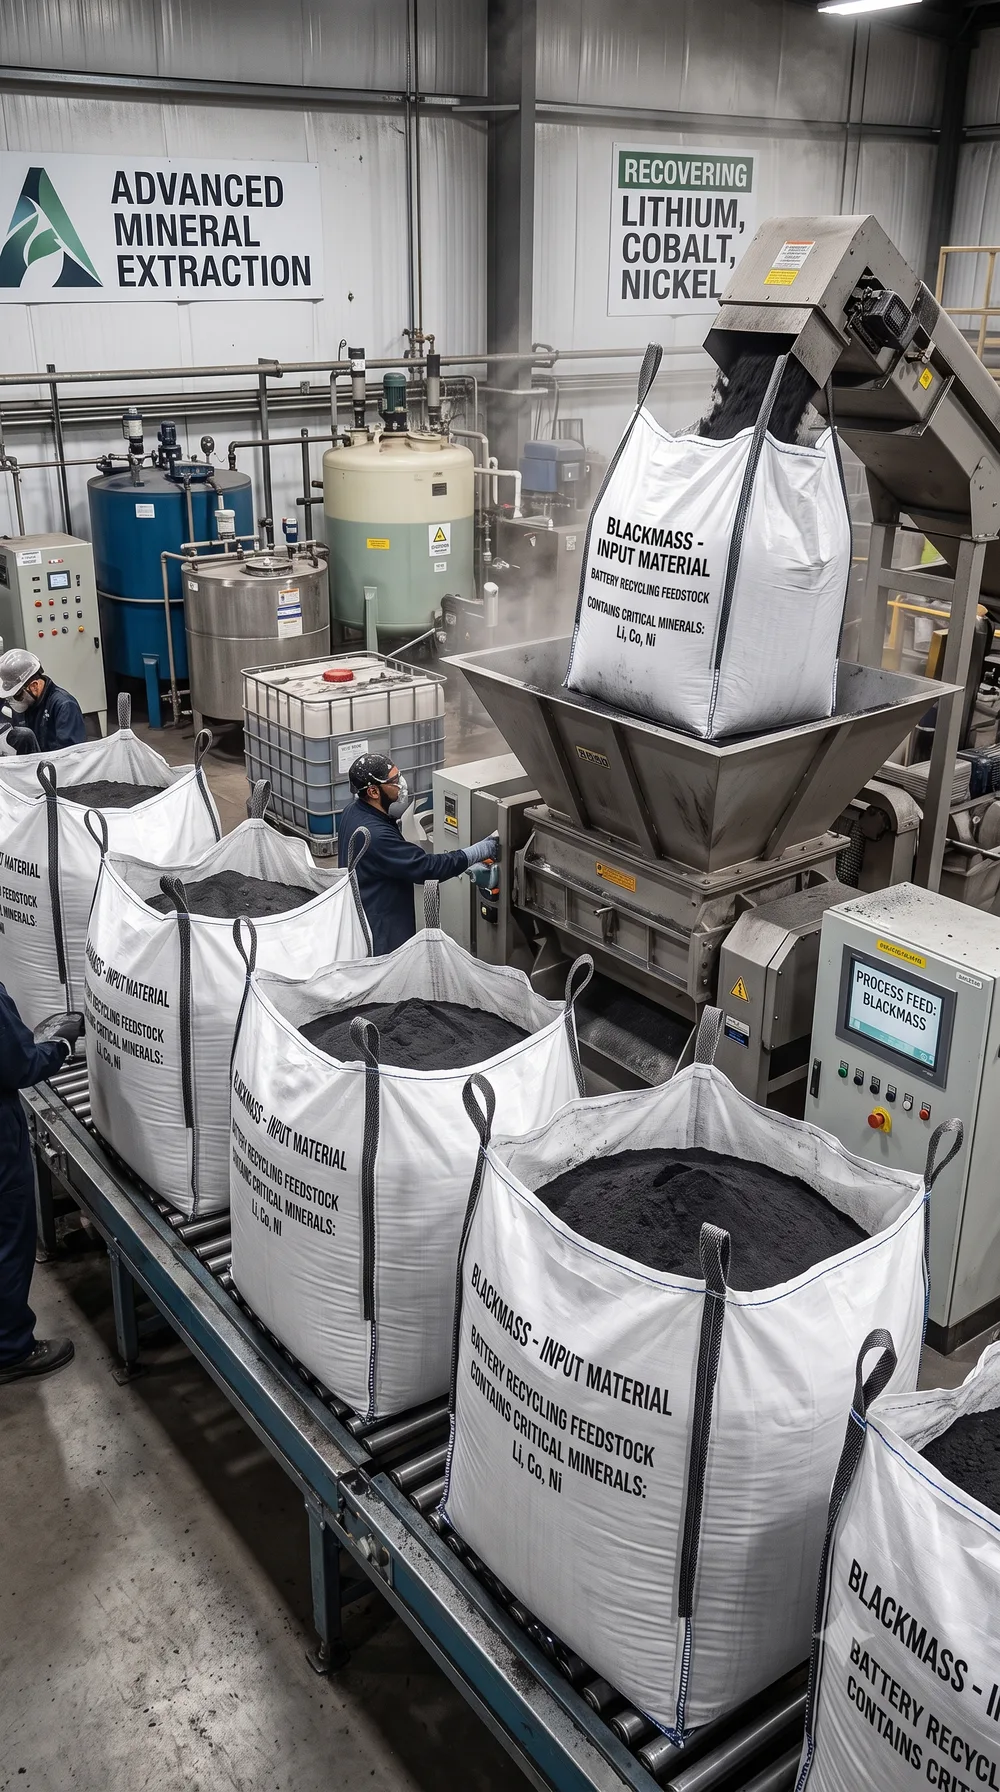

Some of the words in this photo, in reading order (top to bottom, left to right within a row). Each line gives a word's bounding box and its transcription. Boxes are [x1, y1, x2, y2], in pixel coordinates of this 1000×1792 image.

[111, 170, 284, 208] ADVANCED
[624, 158, 747, 187] RECOVERING
[113, 212, 261, 247] MINERAL
[621, 195, 745, 234] LITHIUM,
[622, 232, 736, 269] COBALT,
[116, 254, 311, 287] EXTRACTION
[621, 269, 723, 300] NICKEL
[606, 516, 694, 550] BLACKMASS
[597, 538, 636, 565] INPUT
[638, 550, 711, 577] MATERIAL
[590, 568, 620, 587] BATTERY
[620, 577, 660, 597] RECYCLING
[661, 586, 710, 604] FEEDSTOCK
[587, 596, 621, 618] CONTAINS
[621, 608, 656, 628] CRITICAL
[658, 616, 705, 634] MINERALS:
[616, 625, 627, 642] Li,
[629, 628, 643, 647] Co,
[645, 632, 656, 647] Ni
[4, 854, 41, 879] MATERIAL
[2, 886, 38, 908] FEEDSTOCK
[105, 966, 127, 992] INPUT
[126, 978, 170, 1008] MATERIAL
[856, 969, 904, 1002] PROCESS
[906, 992, 937, 1016] FEED:
[121, 1015, 164, 1043] FEEDSTOCK
[862, 991, 926, 1031] BLACKMASS
[122, 1037, 164, 1065] MINERALS:
[266, 1114, 292, 1148] INPUT
[293, 1131, 347, 1171] MATERIAL
[247, 1142, 283, 1186] RECYCLING
[284, 1170, 339, 1212] FEEDSTOCK
[252, 1174, 283, 1213] CRITICAL
[284, 1199, 336, 1236] MINERALS:
[471, 1262, 532, 1347] BLACKMASS
[539, 1335, 584, 1382] INPUT
[586, 1362, 672, 1417] MATERIAL
[471, 1324, 505, 1382] BATTERY
[506, 1367, 567, 1431] RECYCLING
[570, 1414, 655, 1468] FEEDSTOCK
[470, 1359, 512, 1423] CONTAINS
[513, 1409, 565, 1464] CRITICAL
[568, 1447, 647, 1499] MINERALS:
[512, 1440, 524, 1470] Li,
[527, 1453, 546, 1485] Co,
[549, 1468, 562, 1494] Ni
[848, 1558, 968, 1693] BLACKMASS
[850, 1636, 924, 1728] BATTERY
[847, 1675, 923, 1771] CONTAINS
